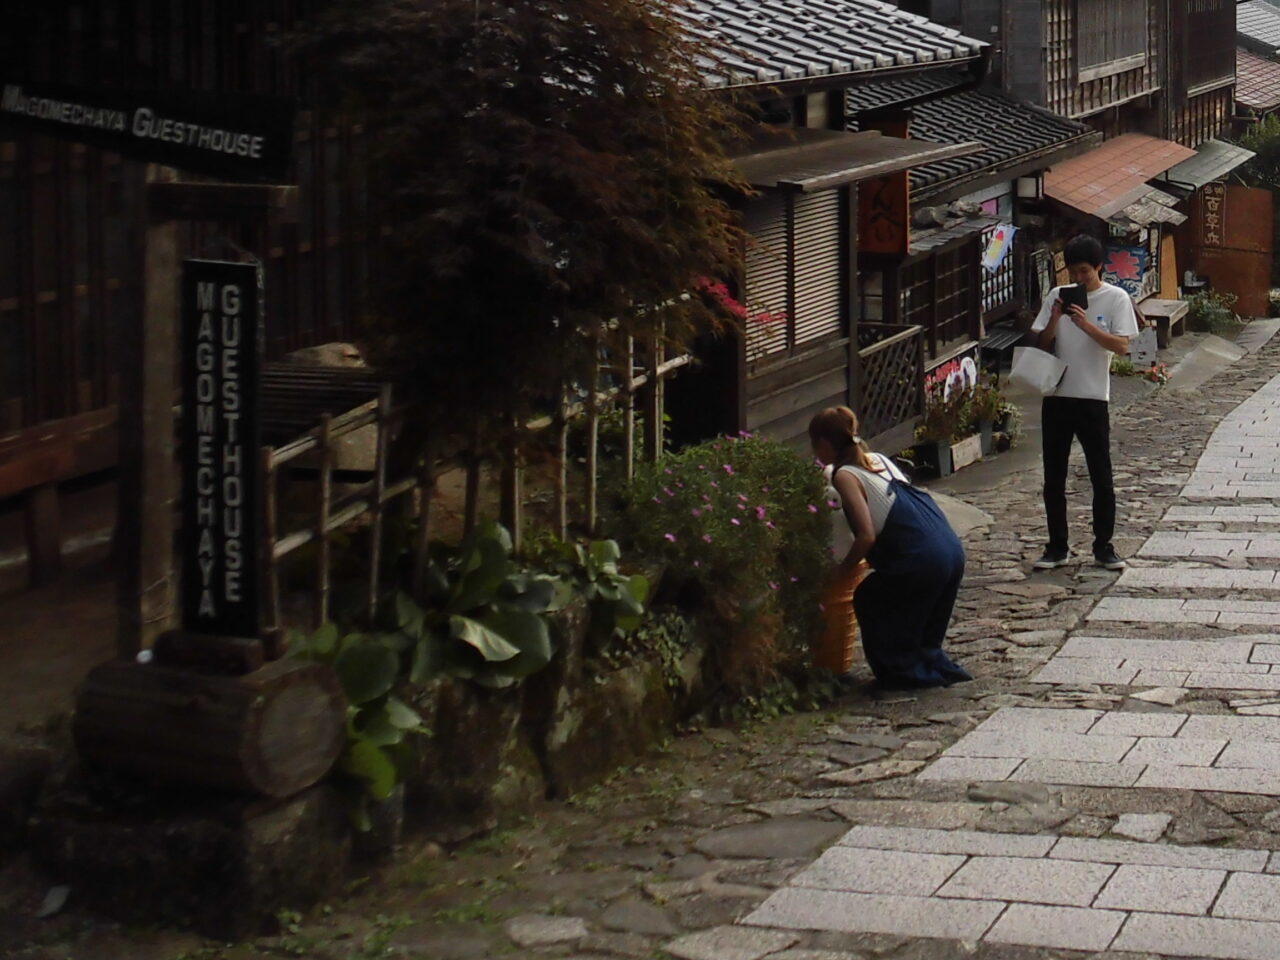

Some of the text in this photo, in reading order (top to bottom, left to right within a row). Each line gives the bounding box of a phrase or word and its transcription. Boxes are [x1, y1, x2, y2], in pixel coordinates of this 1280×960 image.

[132, 106, 265, 159] GUESTHOUSE
[197, 281, 215, 618] MAGOMECHAYA
[220, 284, 242, 603] GUESTHOUSE
